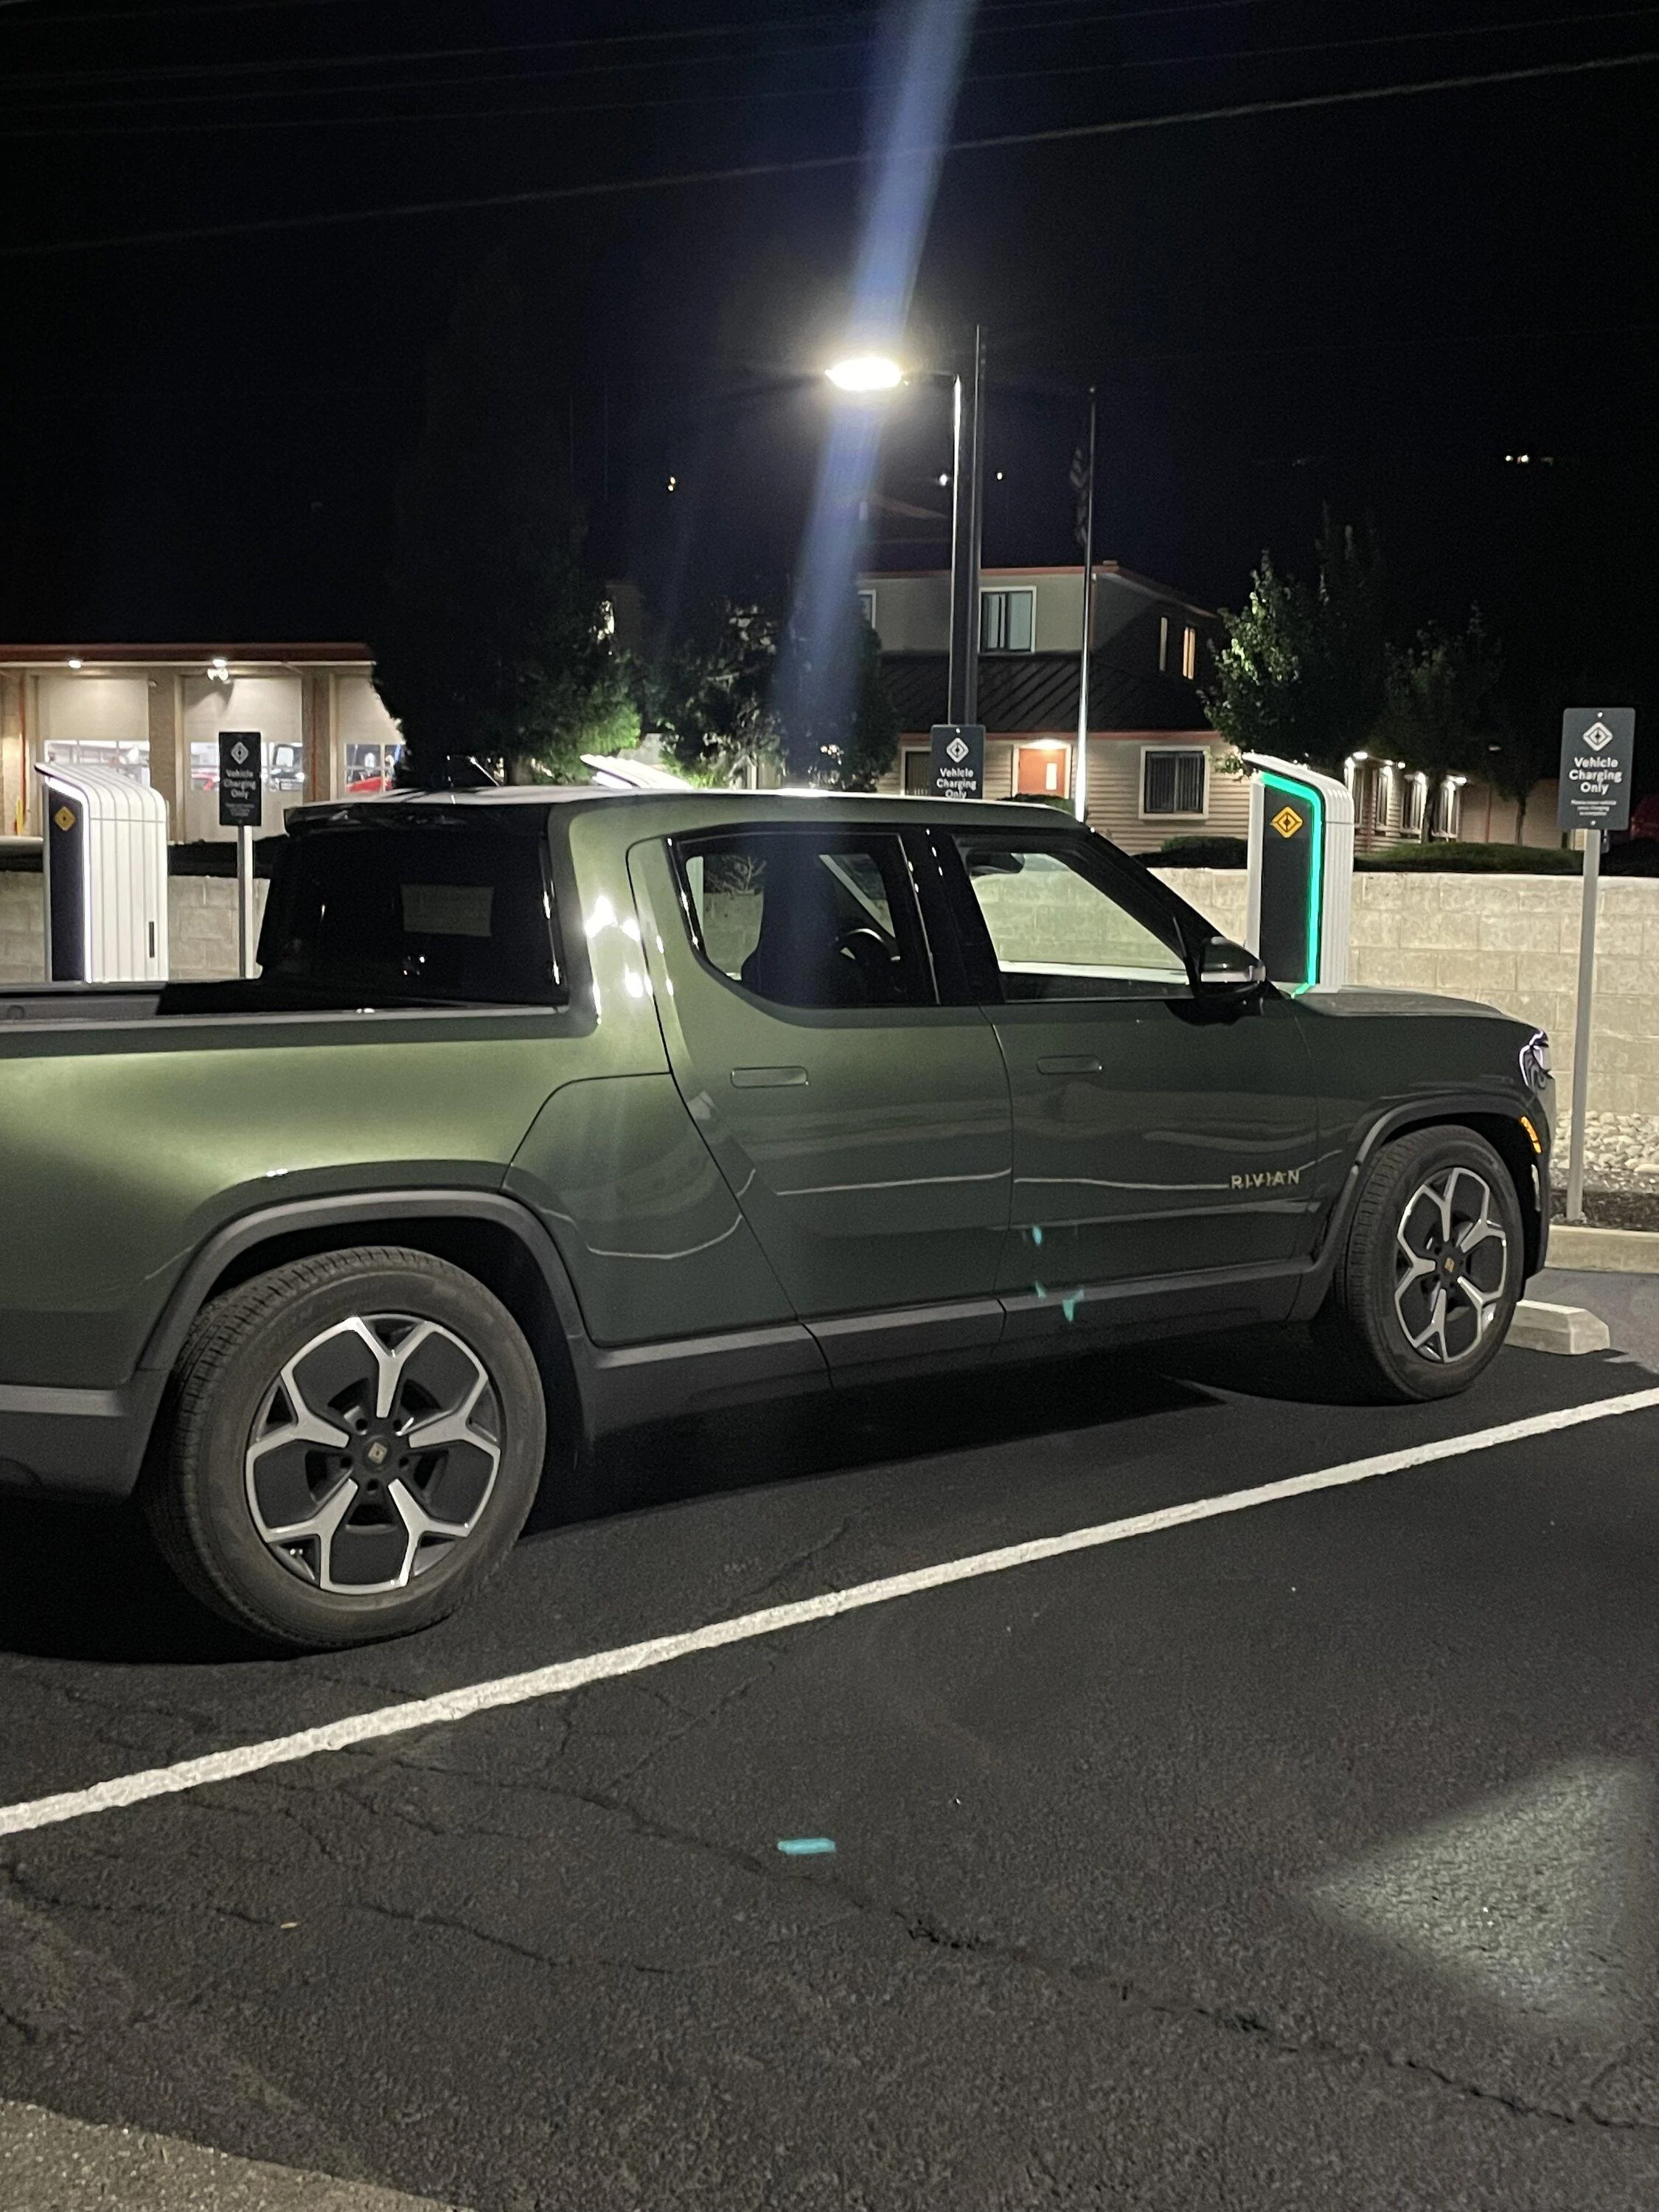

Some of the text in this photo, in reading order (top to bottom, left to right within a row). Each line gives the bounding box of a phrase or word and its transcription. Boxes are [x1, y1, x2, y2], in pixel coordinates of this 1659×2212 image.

[1574, 757, 1618, 768] Vehicle
[940, 768, 973, 777] Vehicle
[1569, 769, 1622, 783] Charging
[936, 779, 976, 790] Charging
[1580, 782, 1609, 796] Only
[231, 789, 249, 799] Only
[945, 789, 967, 799] Only
[1231, 1170, 1301, 1189] RIVIAN
